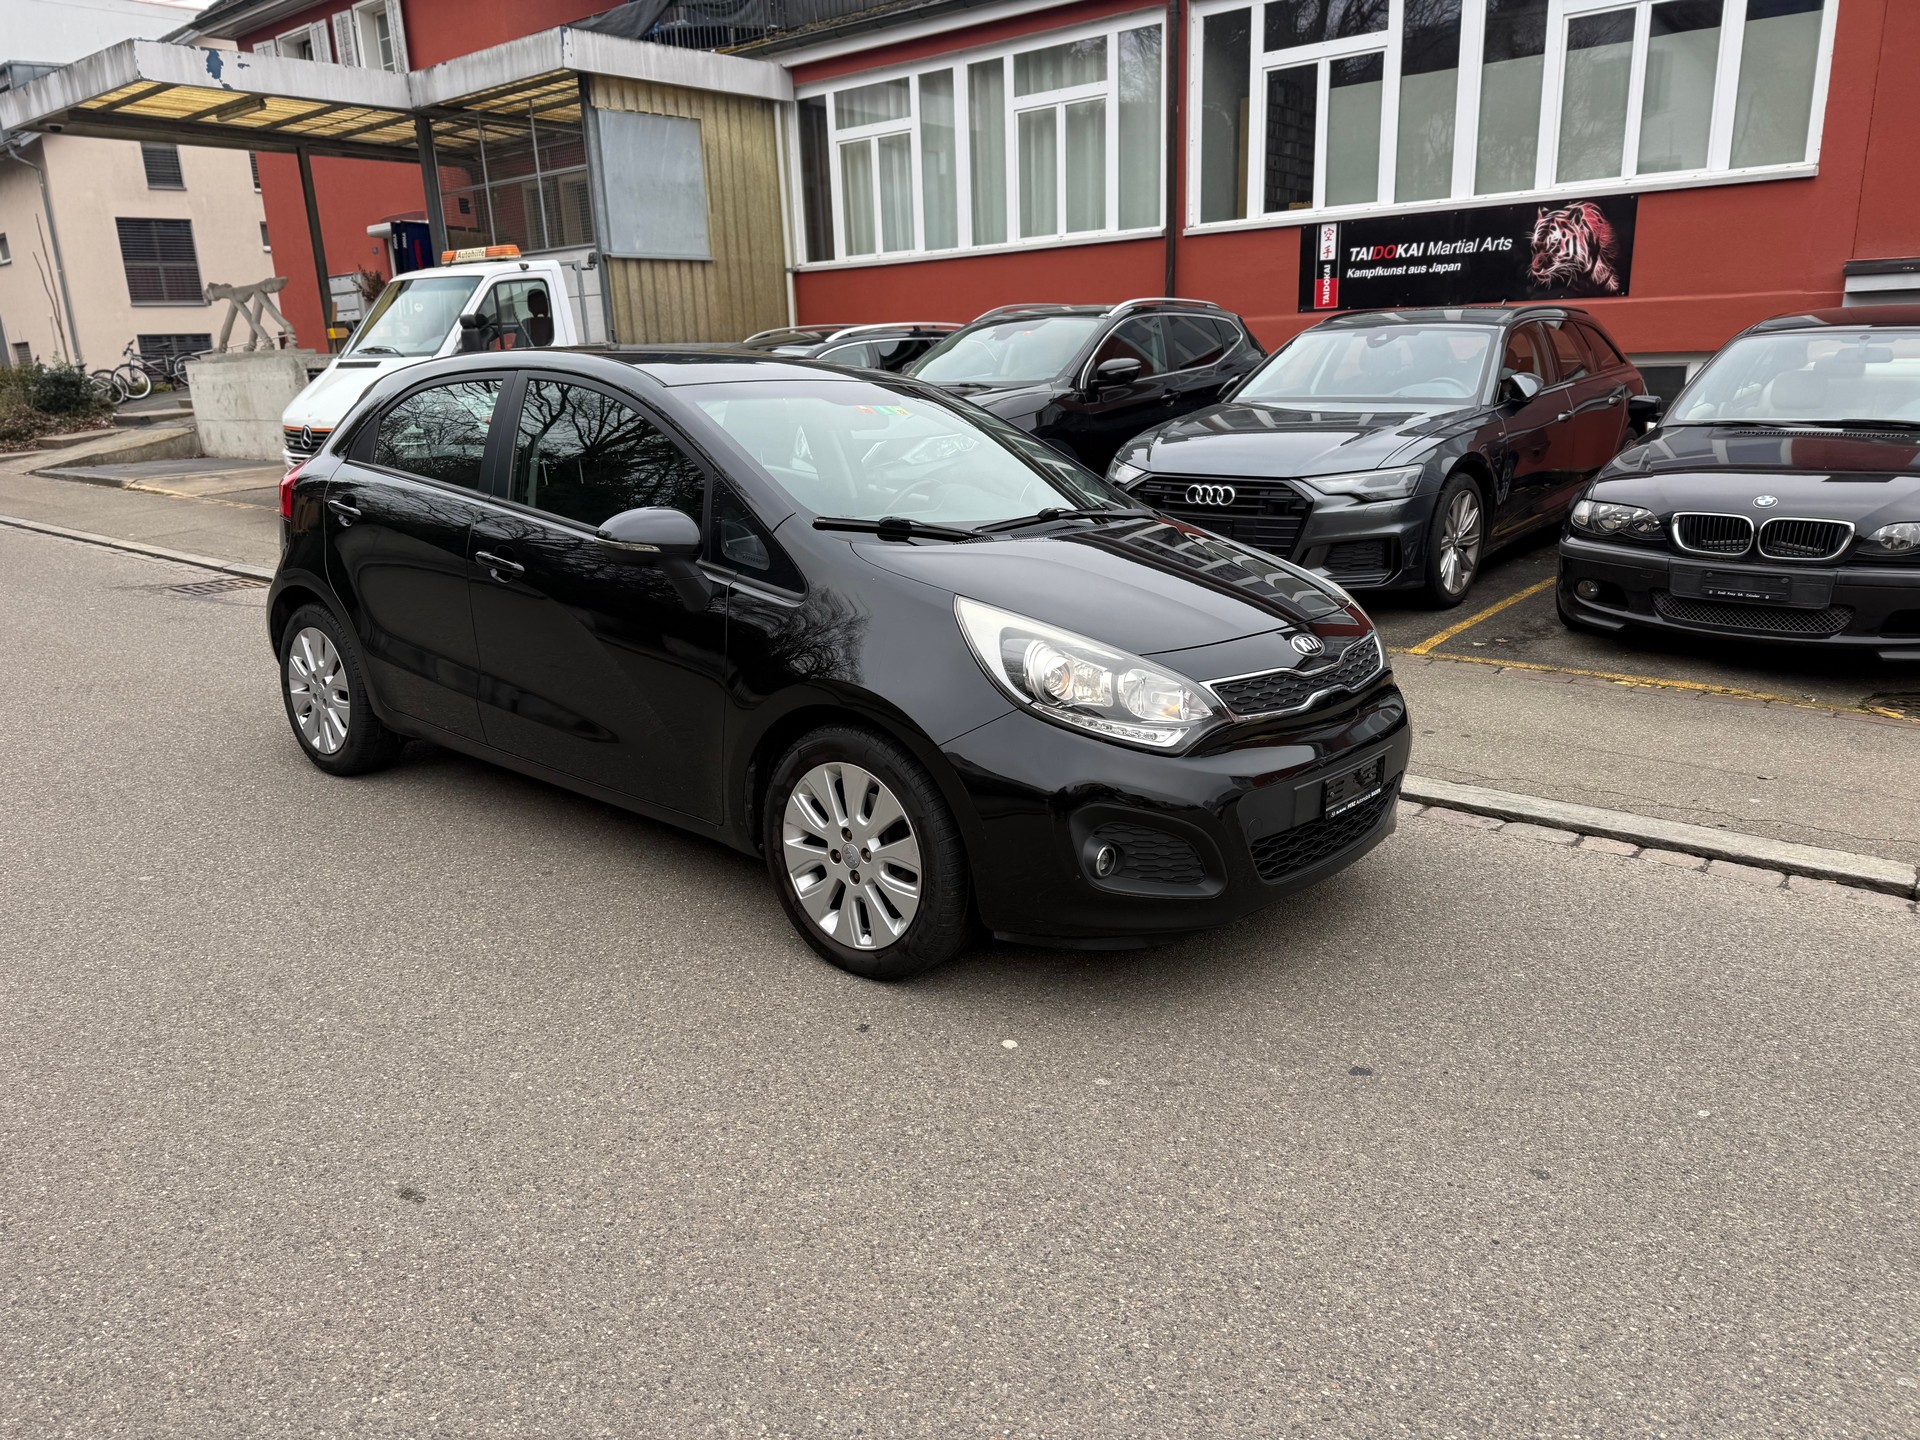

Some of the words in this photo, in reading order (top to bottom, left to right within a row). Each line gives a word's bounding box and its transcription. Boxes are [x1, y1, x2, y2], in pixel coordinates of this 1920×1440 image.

[457, 248, 485, 259] Autohilfe
[1350, 242, 1425, 262] TAIDOKAI
[1427, 237, 1480, 256] Martial
[1480, 236, 1513, 252] Arts
[1346, 265, 1407, 279] Kampfkunst
[1408, 265, 1427, 274] aus
[1428, 262, 1461, 274] Japan
[1322, 264, 1331, 305] TAIDOKAI
[1296, 636, 1322, 652] KIA
